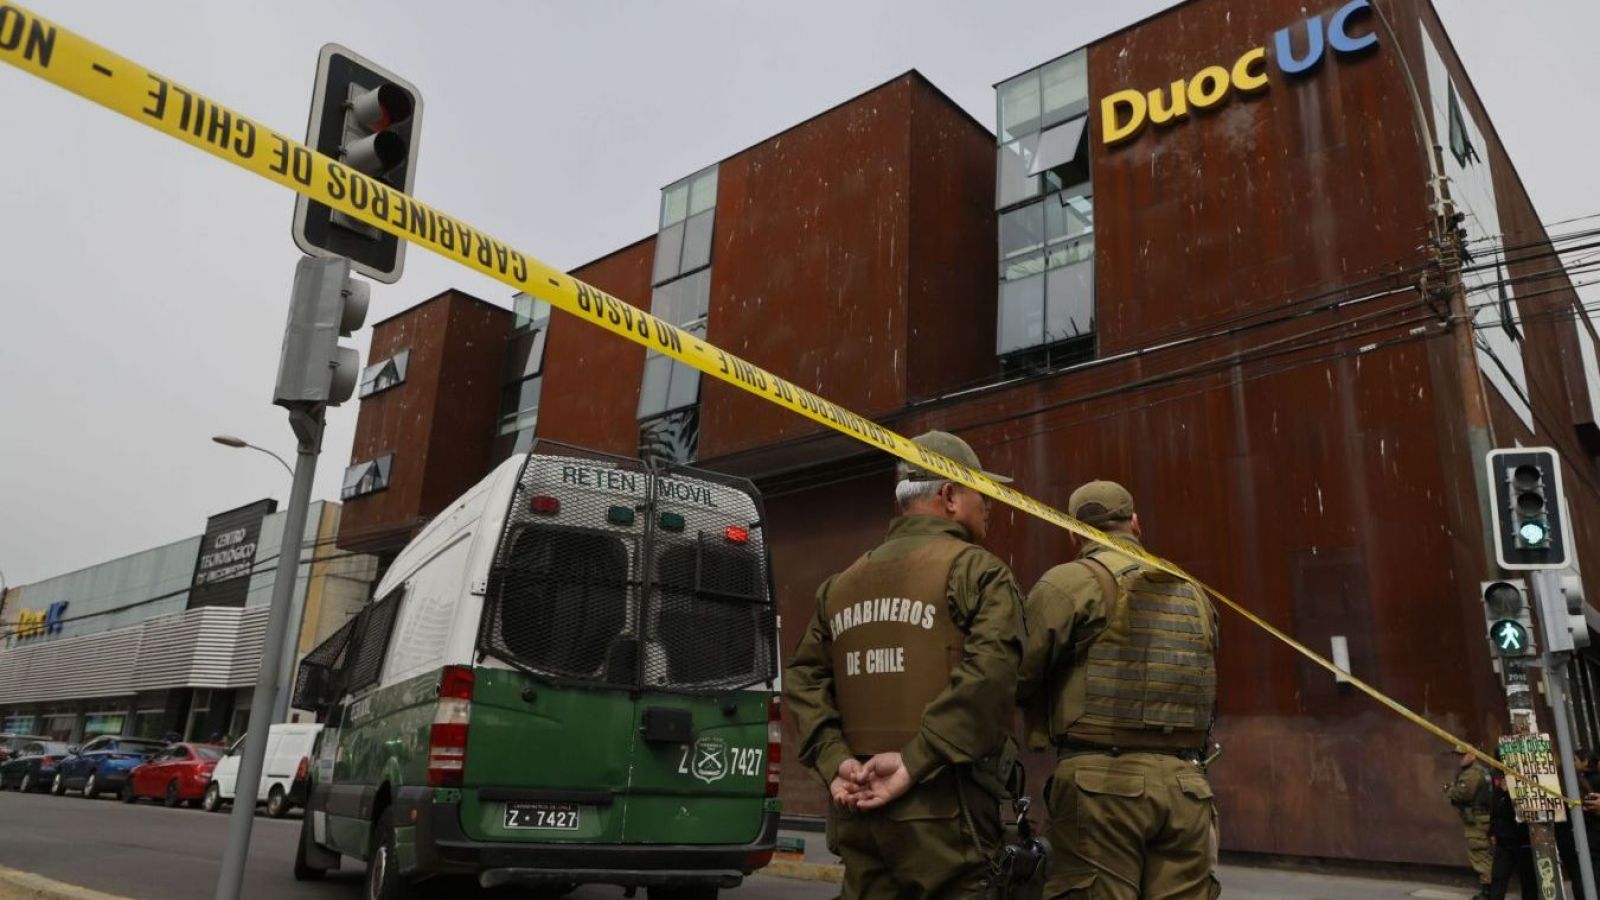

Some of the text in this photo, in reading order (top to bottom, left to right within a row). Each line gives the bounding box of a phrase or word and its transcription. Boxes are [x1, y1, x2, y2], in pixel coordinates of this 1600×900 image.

[1101, 0, 1378, 144] Duoc UC
[142, 73, 256, 159] CHILE
[269, 133, 313, 186] DE
[327, 162, 528, 284] CARABINEROS
[574, 280, 649, 339] PASAR
[654, 318, 682, 353] NO
[718, 350, 767, 391] CHILE
[773, 374, 793, 403] DE
[562, 465, 717, 507] RETEN MOVIL
[831, 597, 936, 641] CARABINEROS
[846, 647, 904, 676] DE CHILE
[678, 745, 763, 776] Z 7427
